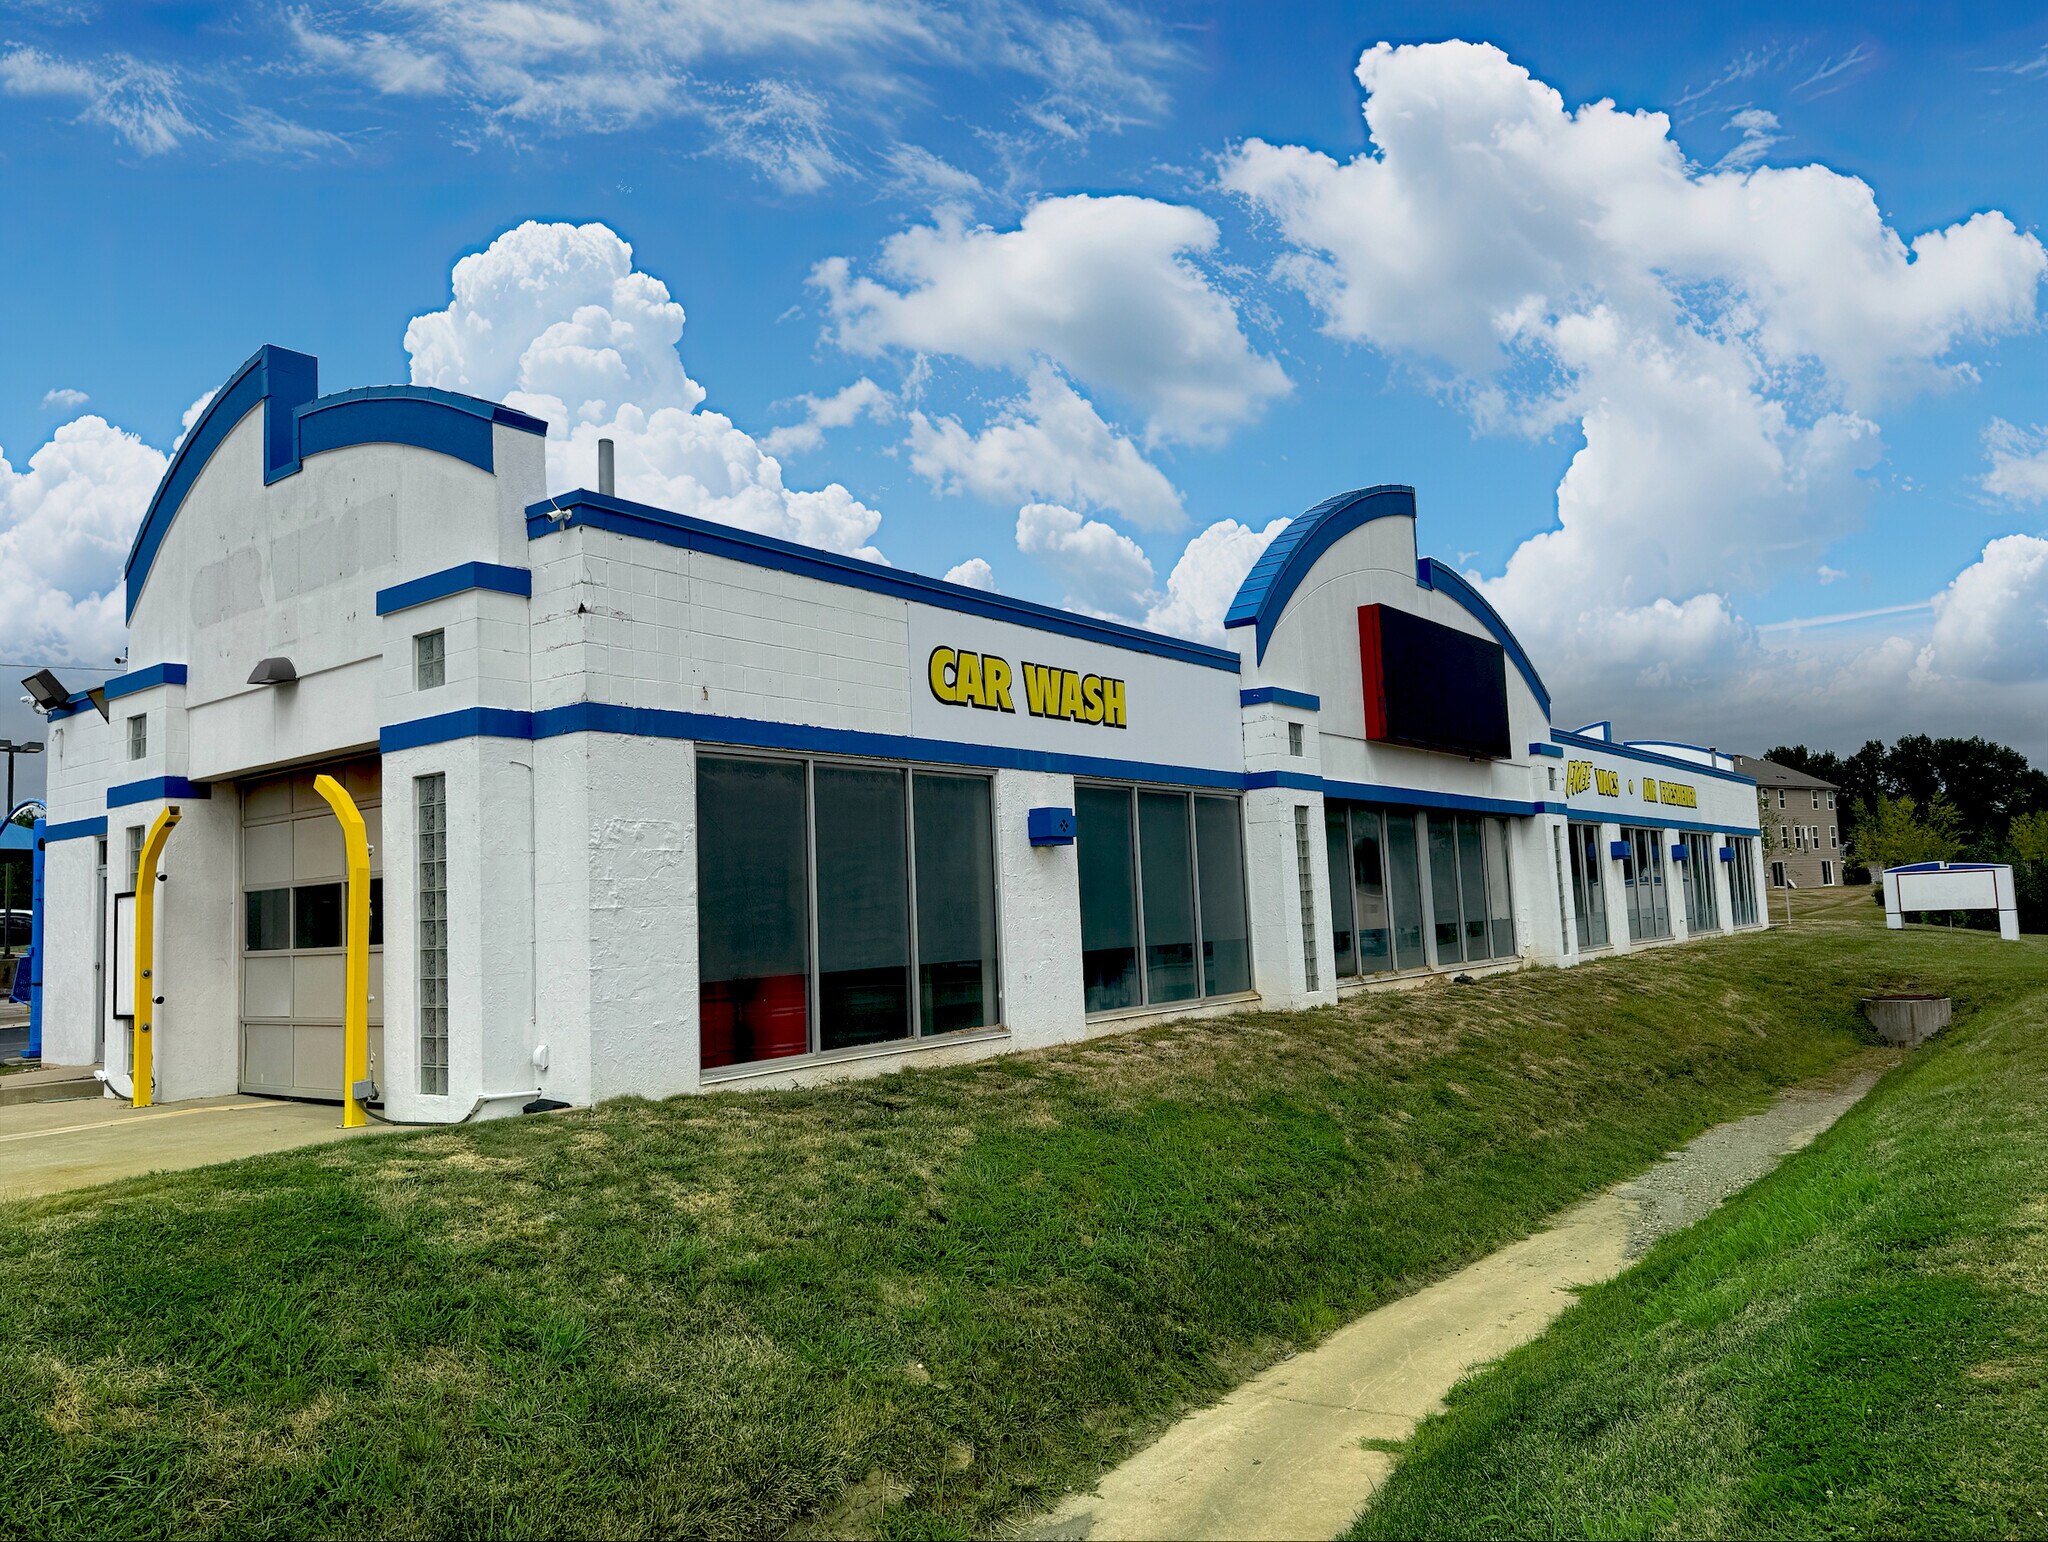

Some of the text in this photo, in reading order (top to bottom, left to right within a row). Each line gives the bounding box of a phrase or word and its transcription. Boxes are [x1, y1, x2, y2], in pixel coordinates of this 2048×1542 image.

[928, 645, 1127, 729] CAR WASH
[1566, 760, 1697, 809] FREE VACS AIR FRESHENER
